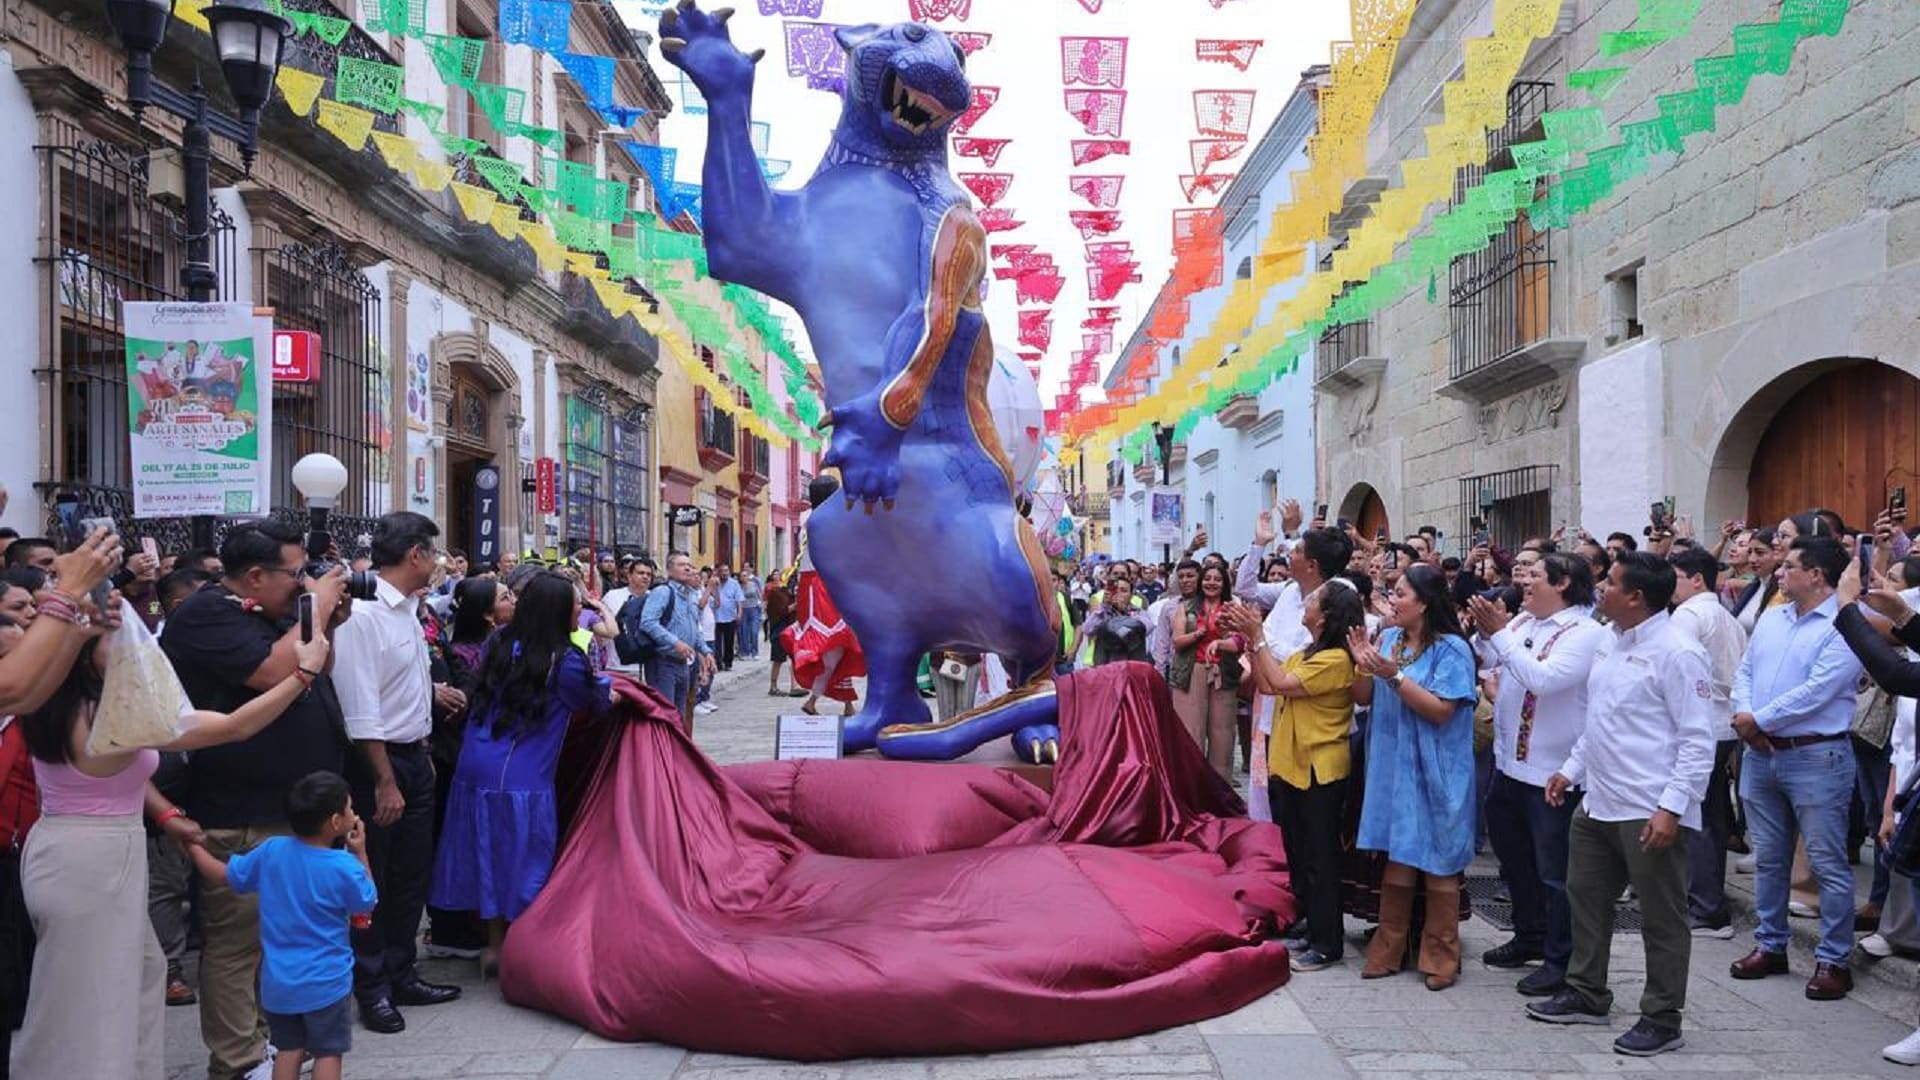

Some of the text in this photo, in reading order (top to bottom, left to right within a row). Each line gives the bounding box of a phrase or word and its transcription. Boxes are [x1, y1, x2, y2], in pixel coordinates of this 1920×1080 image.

[142, 464, 160, 472] DEL
[164, 464, 173, 472] 17
[175, 463, 188, 471] AL
[222, 462, 250, 470] JULIO
